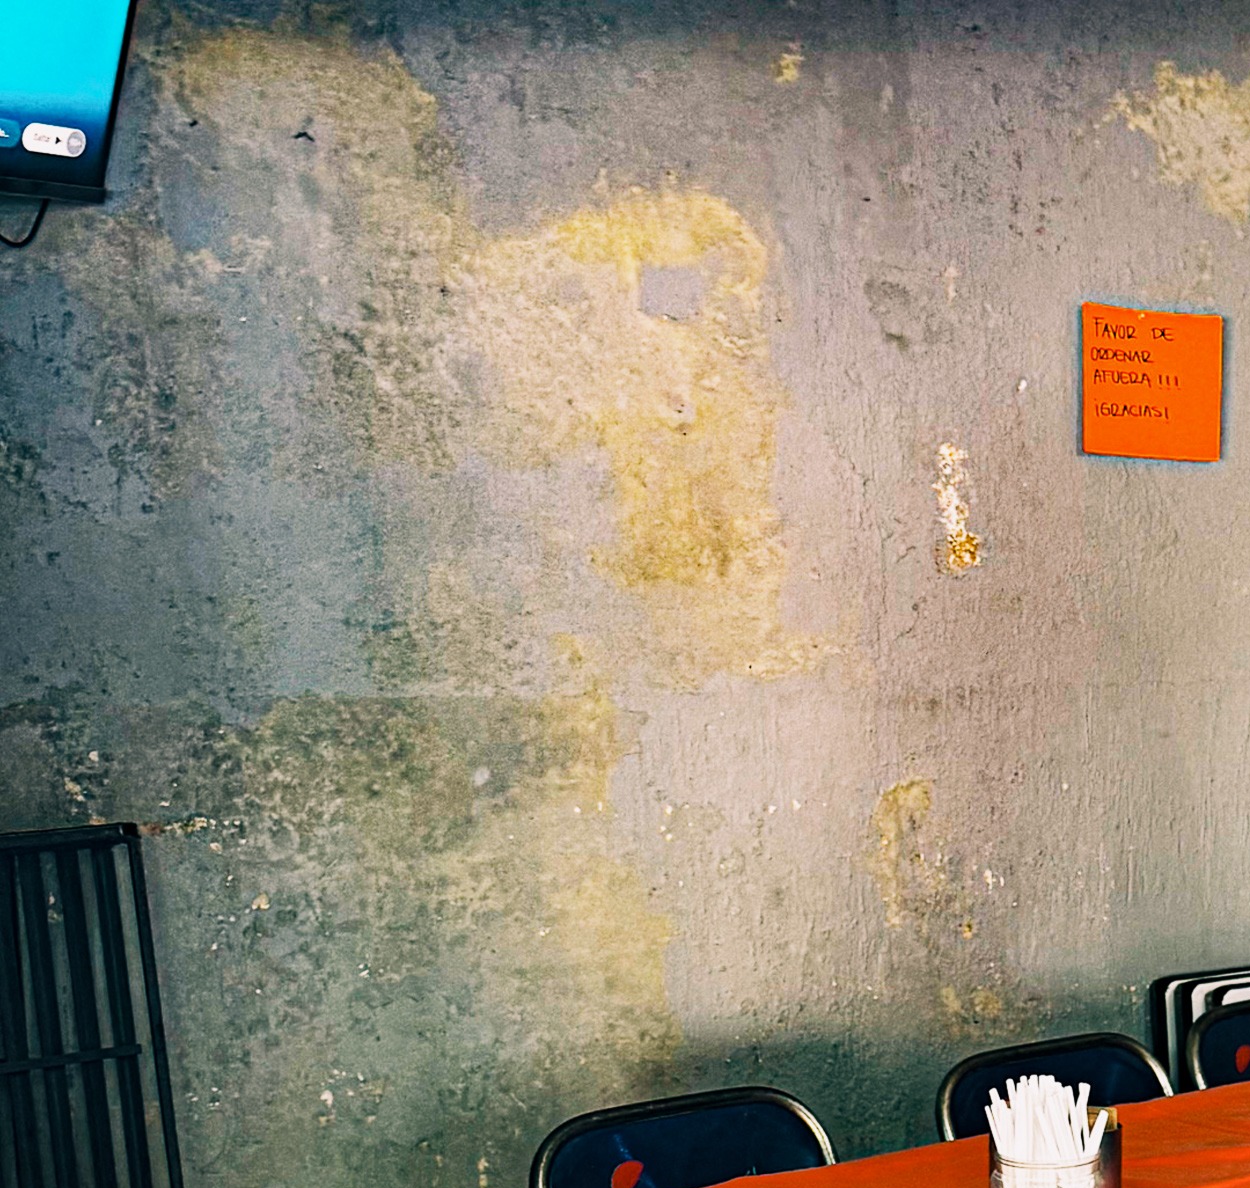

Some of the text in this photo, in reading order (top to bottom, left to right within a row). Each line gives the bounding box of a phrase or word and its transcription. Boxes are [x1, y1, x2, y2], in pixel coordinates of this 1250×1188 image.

[1093, 317, 1175, 341] FAVOR DE
[1090, 346, 1153, 363] ORDENAR
